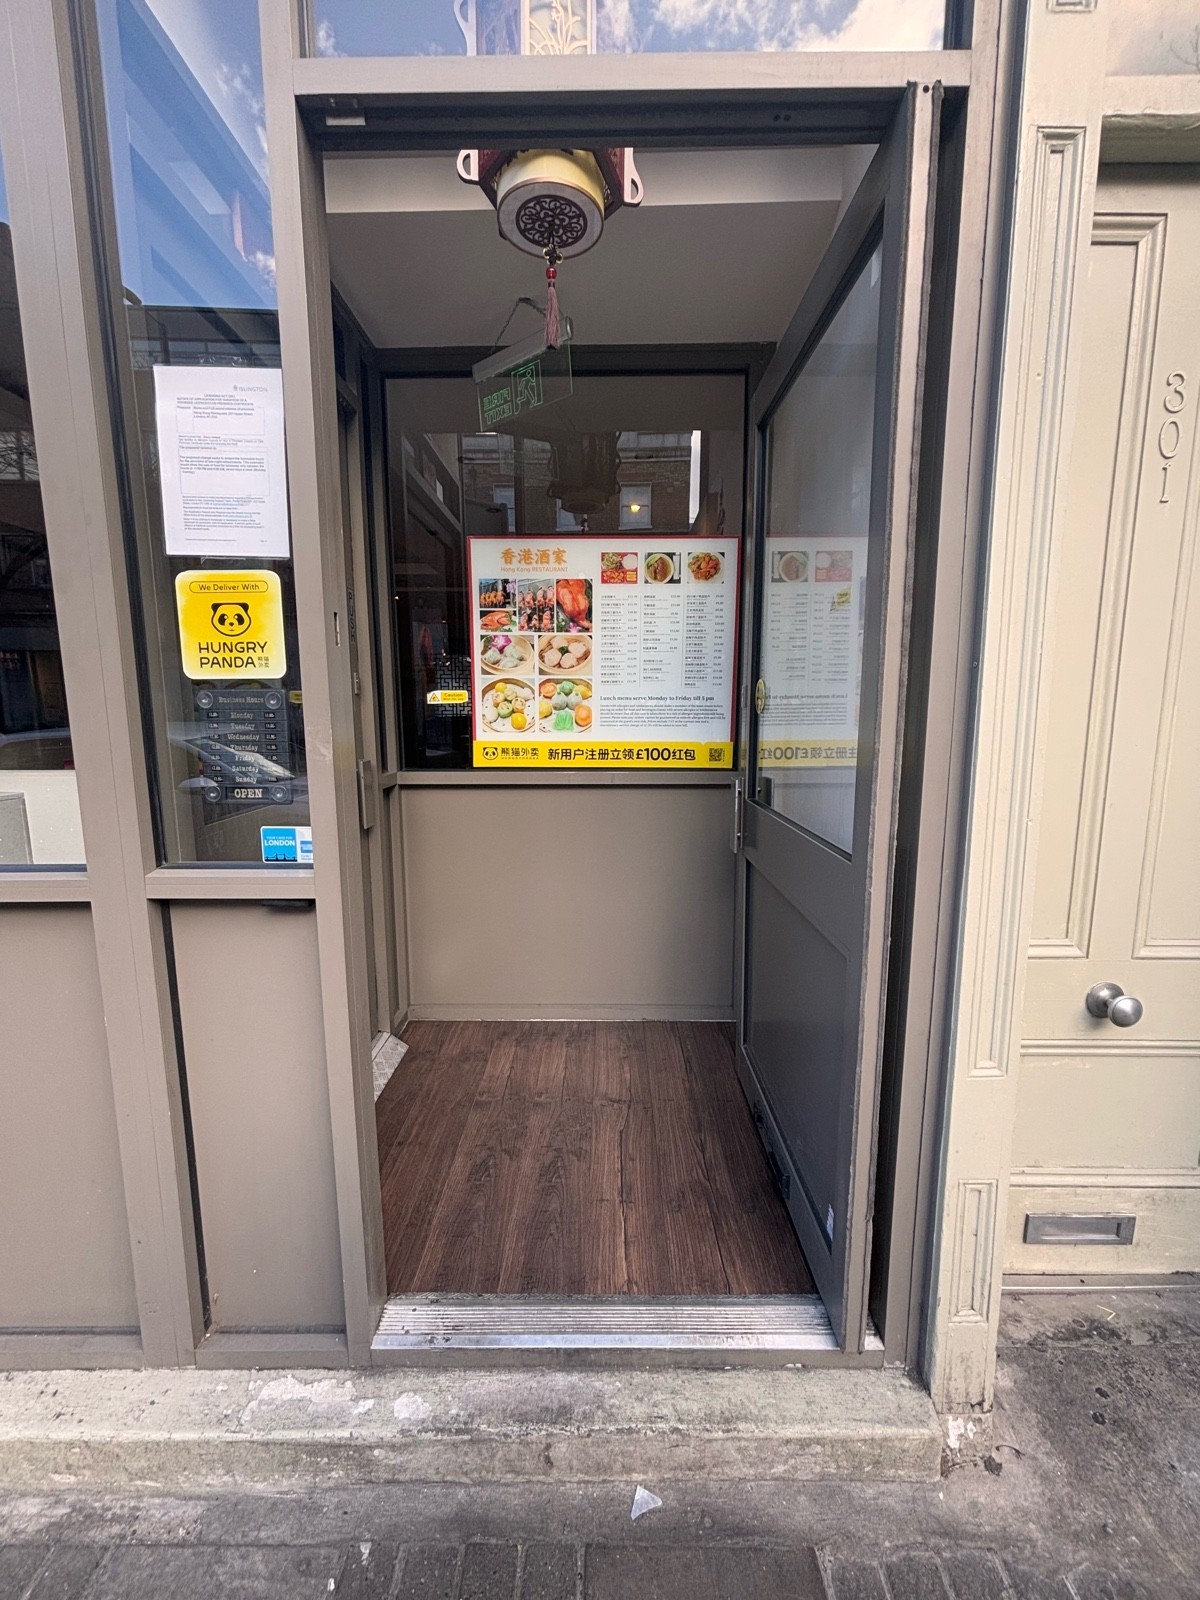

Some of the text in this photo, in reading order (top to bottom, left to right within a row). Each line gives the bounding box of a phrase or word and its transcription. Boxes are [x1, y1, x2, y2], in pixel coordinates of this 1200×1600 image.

[1158, 371, 1186, 503] 301
[501, 547, 568, 566] 香港酒家
[198, 583, 260, 591] We Deliver With
[198, 641, 268, 654] HUNGRY
[199, 656, 257, 669] PANDA
[230, 711, 254, 720] Monday
[230, 722, 256, 731] Tuesday
[226, 733, 260, 742] Wednesday
[230, 744, 259, 752] Thursday
[501, 747, 540, 757] 熊猫外卖
[235, 754, 256, 762] Friday
[548, 747, 697, 762] 新用户注册立领£100红包
[231, 765, 259, 774] Saturday
[235, 776, 258, 784] Sunday
[234, 788, 263, 798] OPEN
[264, 839, 296, 847] LONDON
